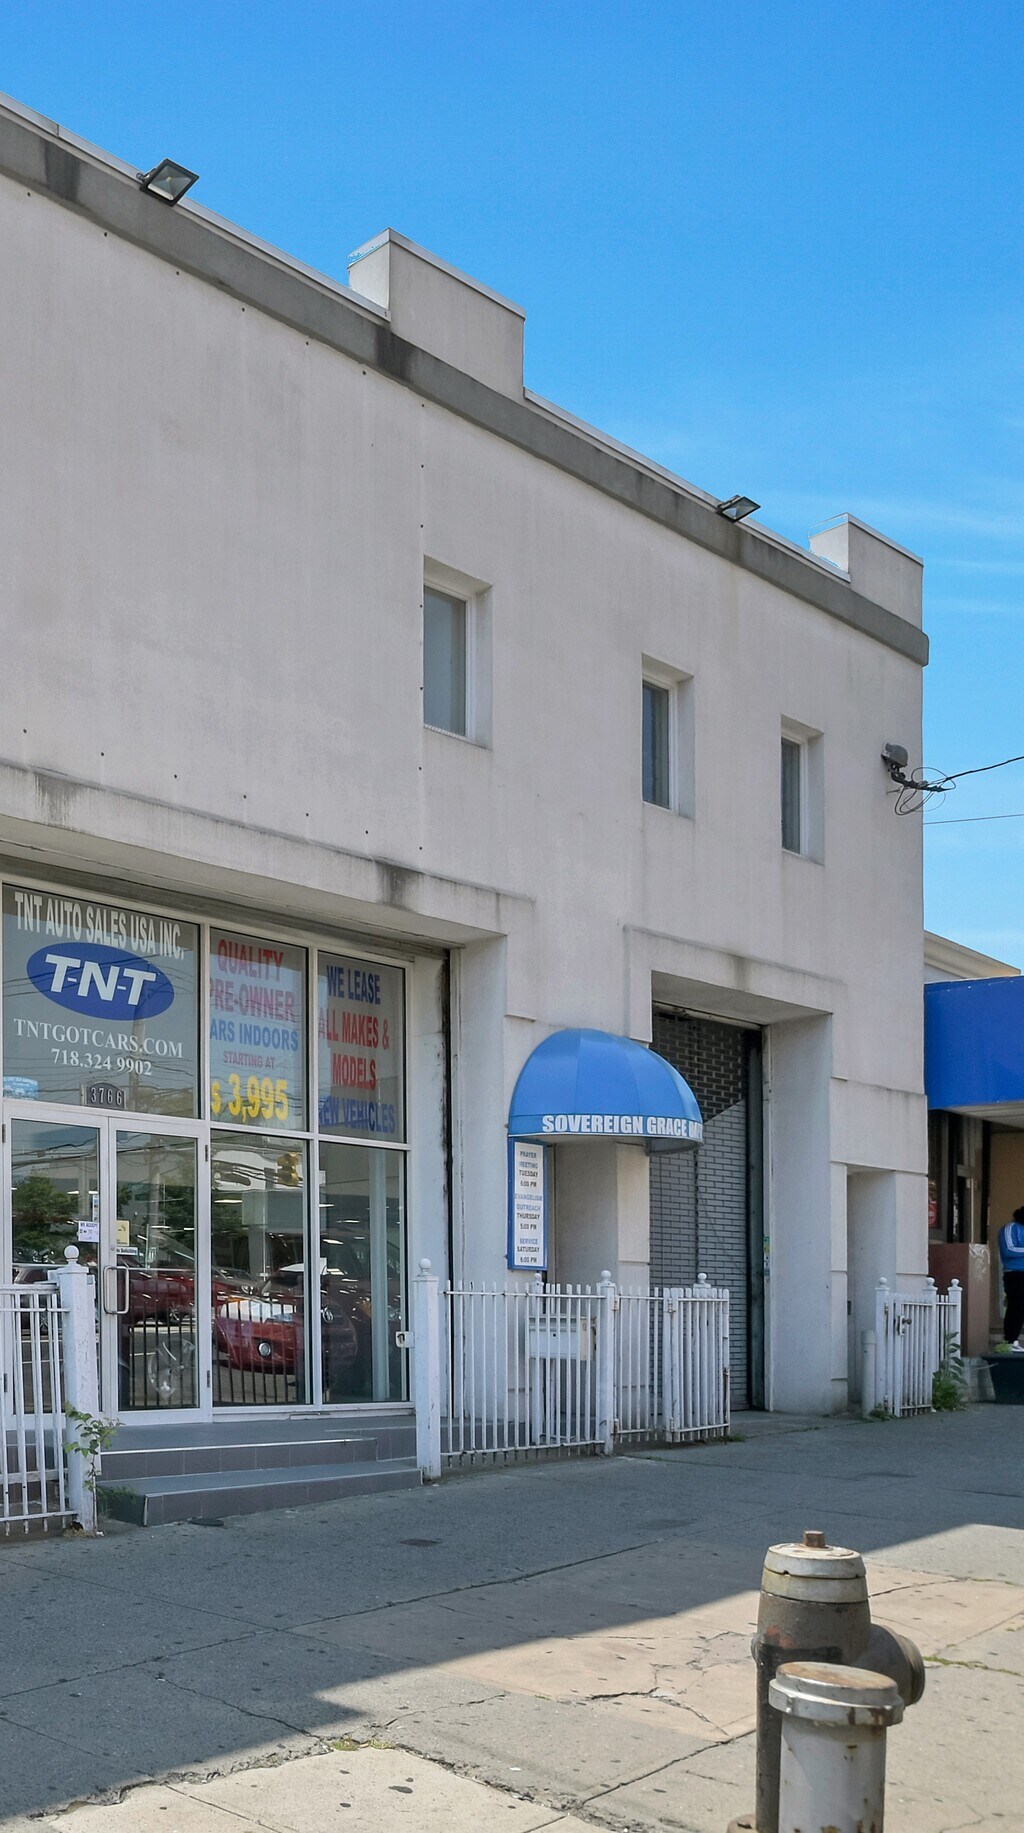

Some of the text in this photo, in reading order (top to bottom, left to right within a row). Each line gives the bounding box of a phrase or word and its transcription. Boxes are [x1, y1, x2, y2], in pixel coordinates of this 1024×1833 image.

[15, 892, 185, 960] TNT AUTO SALES USA INC.
[217, 939, 285, 982] QUALITY
[45, 953, 157, 1006] T-N-T
[326, 965, 381, 1005] WE LEASE
[14, 1018, 184, 1059] TNTGOTCARS.COM
[239, 1022, 299, 1052] INDOORS
[342, 1011, 379, 1049] MAKES
[382, 1018, 390, 1051] &
[51, 1048, 152, 1076] 718.324 9902
[223, 1050, 275, 1069] STARTING AT
[333, 1053, 377, 1091] MODELS
[90, 1087, 123, 1106] 3766
[228, 1073, 289, 1124] 3,995
[342, 1097, 396, 1134] VEHICLES
[542, 1115, 644, 1134] SOVEREIGN
[646, 1116, 688, 1137] GRACE
[516, 1203, 541, 1212] OUTREACH
[516, 1212, 541, 1220] THURSDAY
[519, 1237, 539, 1245] SERVICE
